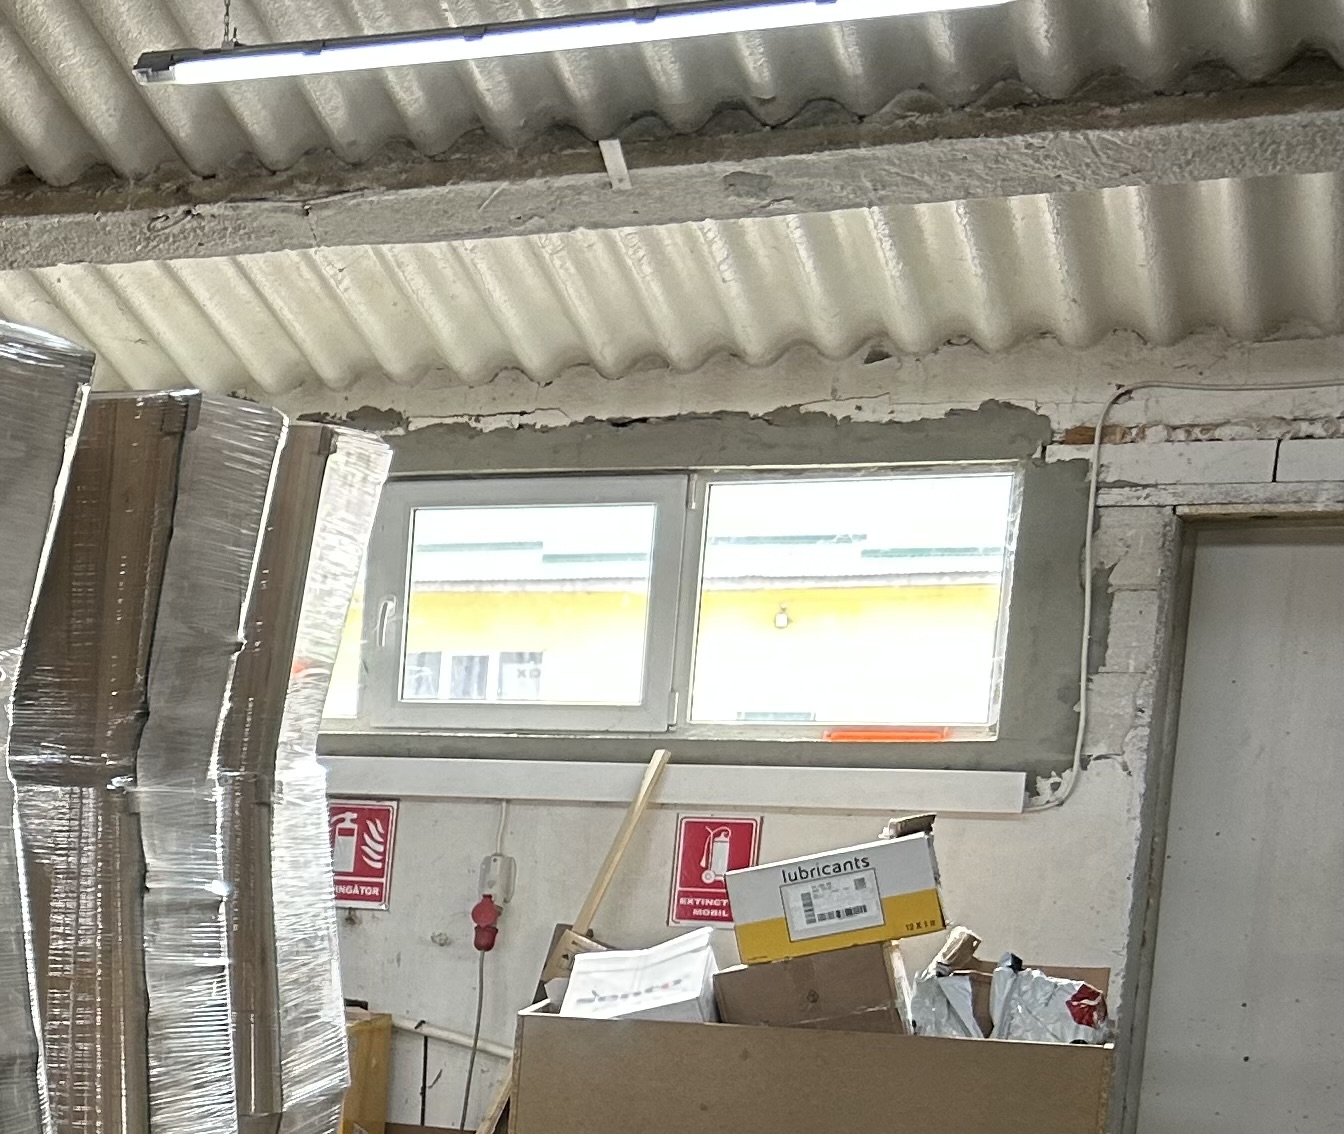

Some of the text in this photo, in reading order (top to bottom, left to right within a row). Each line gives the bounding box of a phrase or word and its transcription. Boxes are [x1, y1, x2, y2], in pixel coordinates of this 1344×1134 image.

[782, 855, 871, 884] lubricants
[335, 883, 380, 896] INGĂTOR
[679, 897, 729, 907] EXTINCT
[692, 908, 729, 917] MOBIL
